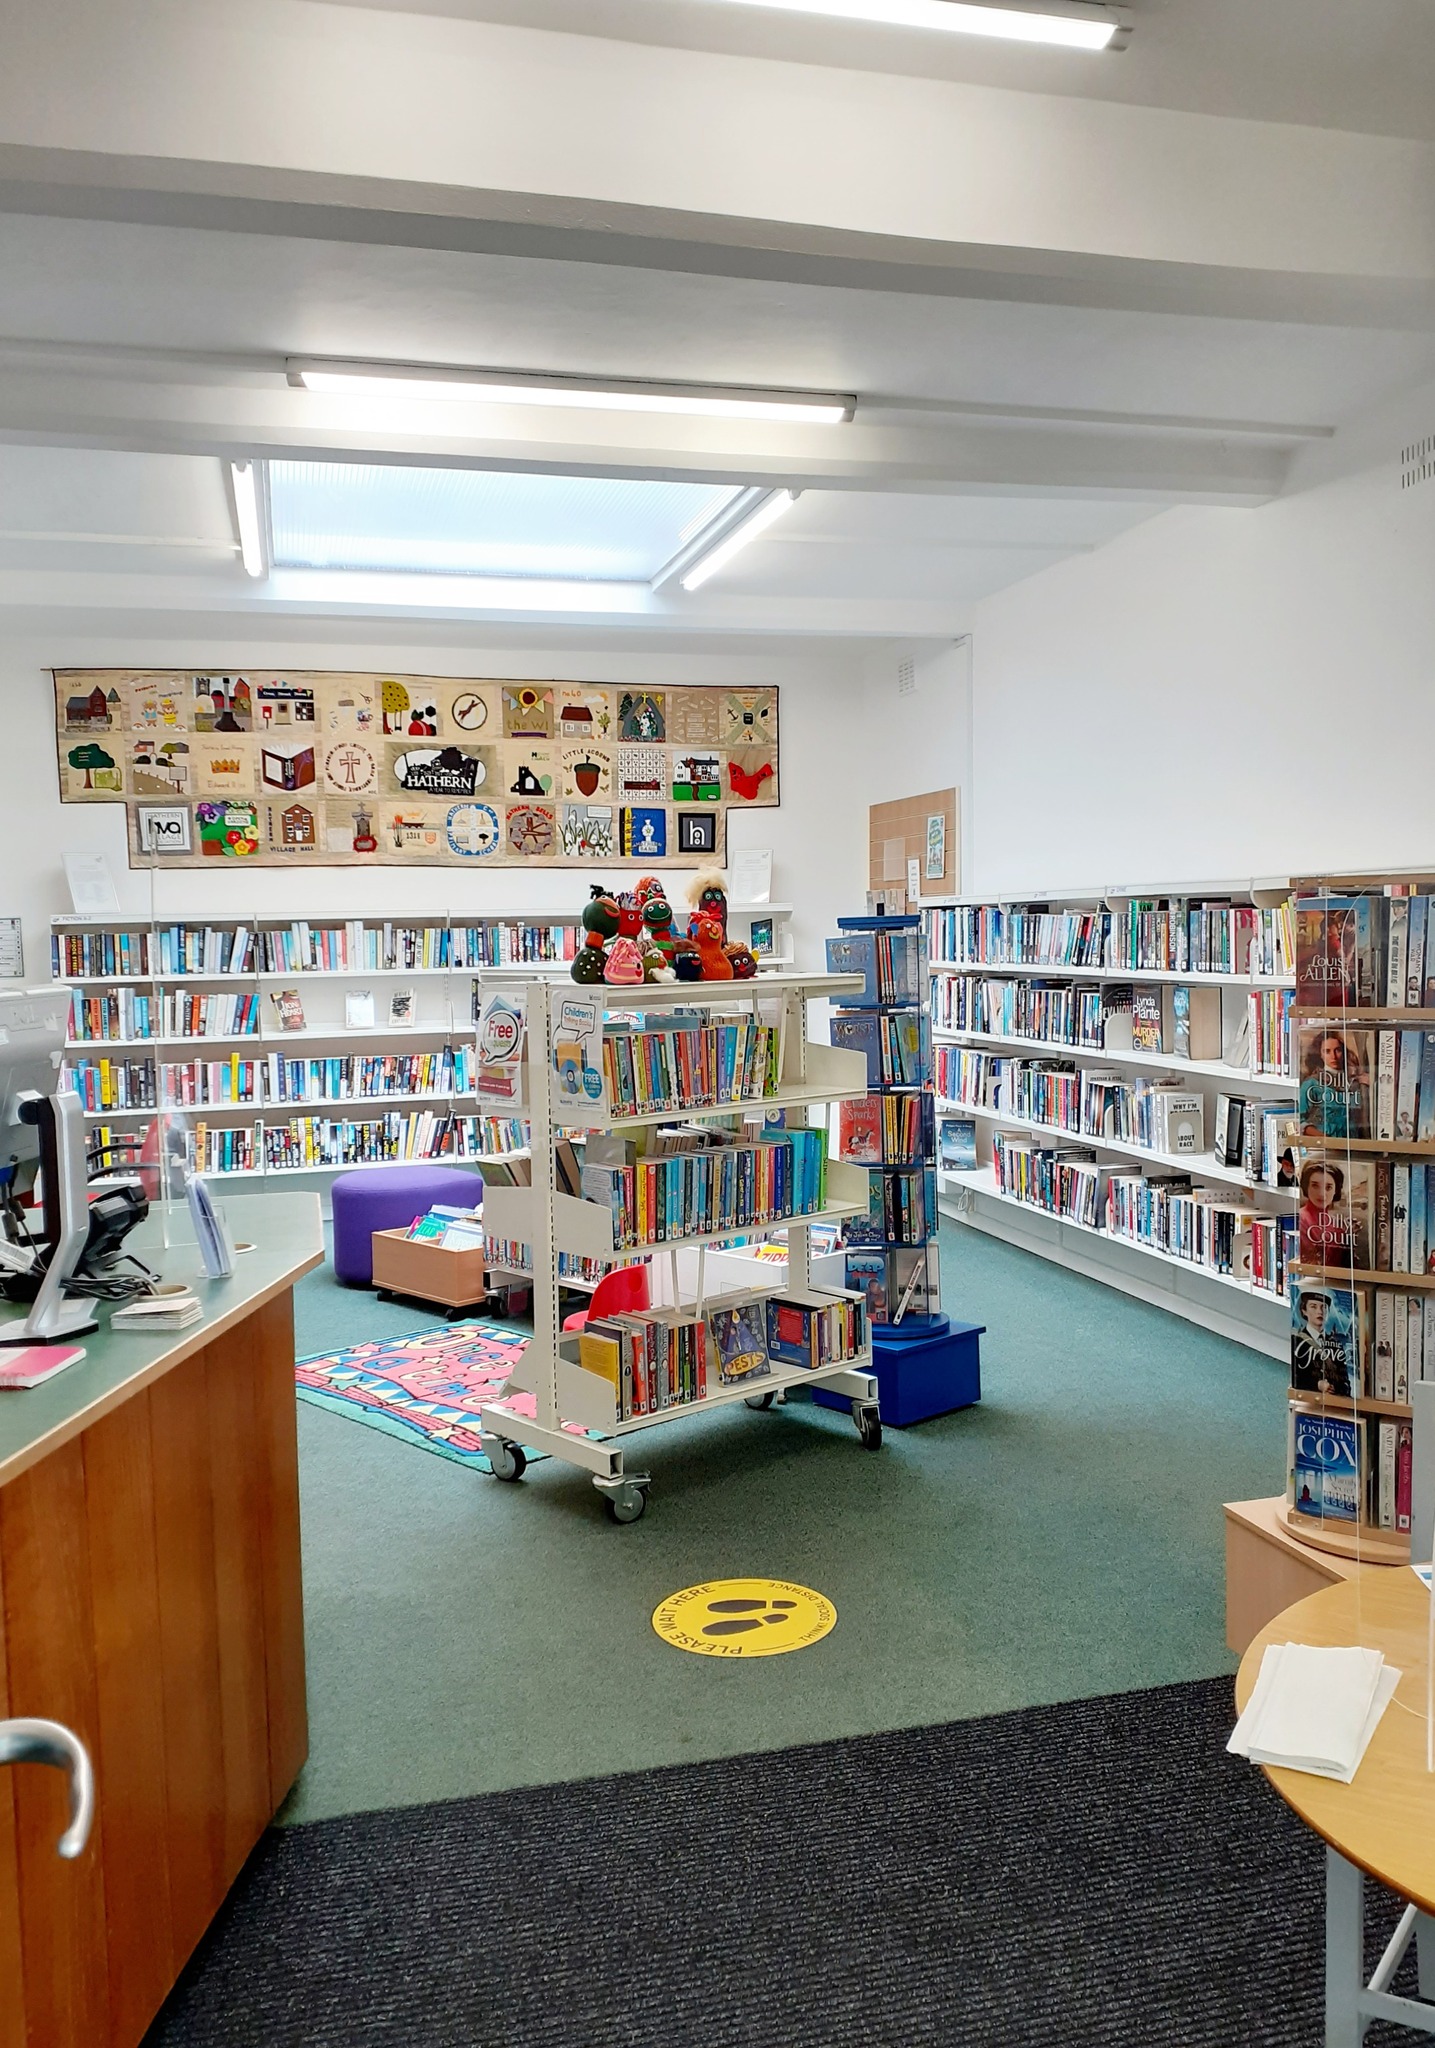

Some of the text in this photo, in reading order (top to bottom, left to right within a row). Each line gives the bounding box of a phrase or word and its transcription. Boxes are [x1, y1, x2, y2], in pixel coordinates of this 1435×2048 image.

[507, 719, 548, 731] the WI
[407, 775, 472, 789] HATHERN
[1300, 966, 1351, 983] ALLEN
[1136, 995, 1156, 1007] Lynda
[564, 1006, 593, 1020] Children's
[1132, 1004, 1160, 1020] Plante
[488, 1020, 513, 1038] Free
[1132, 1026, 1160, 1038] MURDER
[1385, 1035, 1394, 1071] NADINE
[585, 1072, 600, 1084] FREE
[1318, 1070, 1355, 1090] Dilly
[1306, 1085, 1361, 1106] Court
[847, 1108, 876, 1121] Sparks
[1318, 1212, 1350, 1233] Dilly
[1306, 1225, 1359, 1247] Court
[724, 1351, 765, 1375] PESTS
[1297, 1434, 1357, 1467] COX
[1386, 1427, 1394, 1459] NADINE
[768, 1582, 819, 1602] DISTANCE
[658, 1585, 743, 1655] PLEASE WAIT HERE
[815, 1600, 831, 1621] SOCIAL
